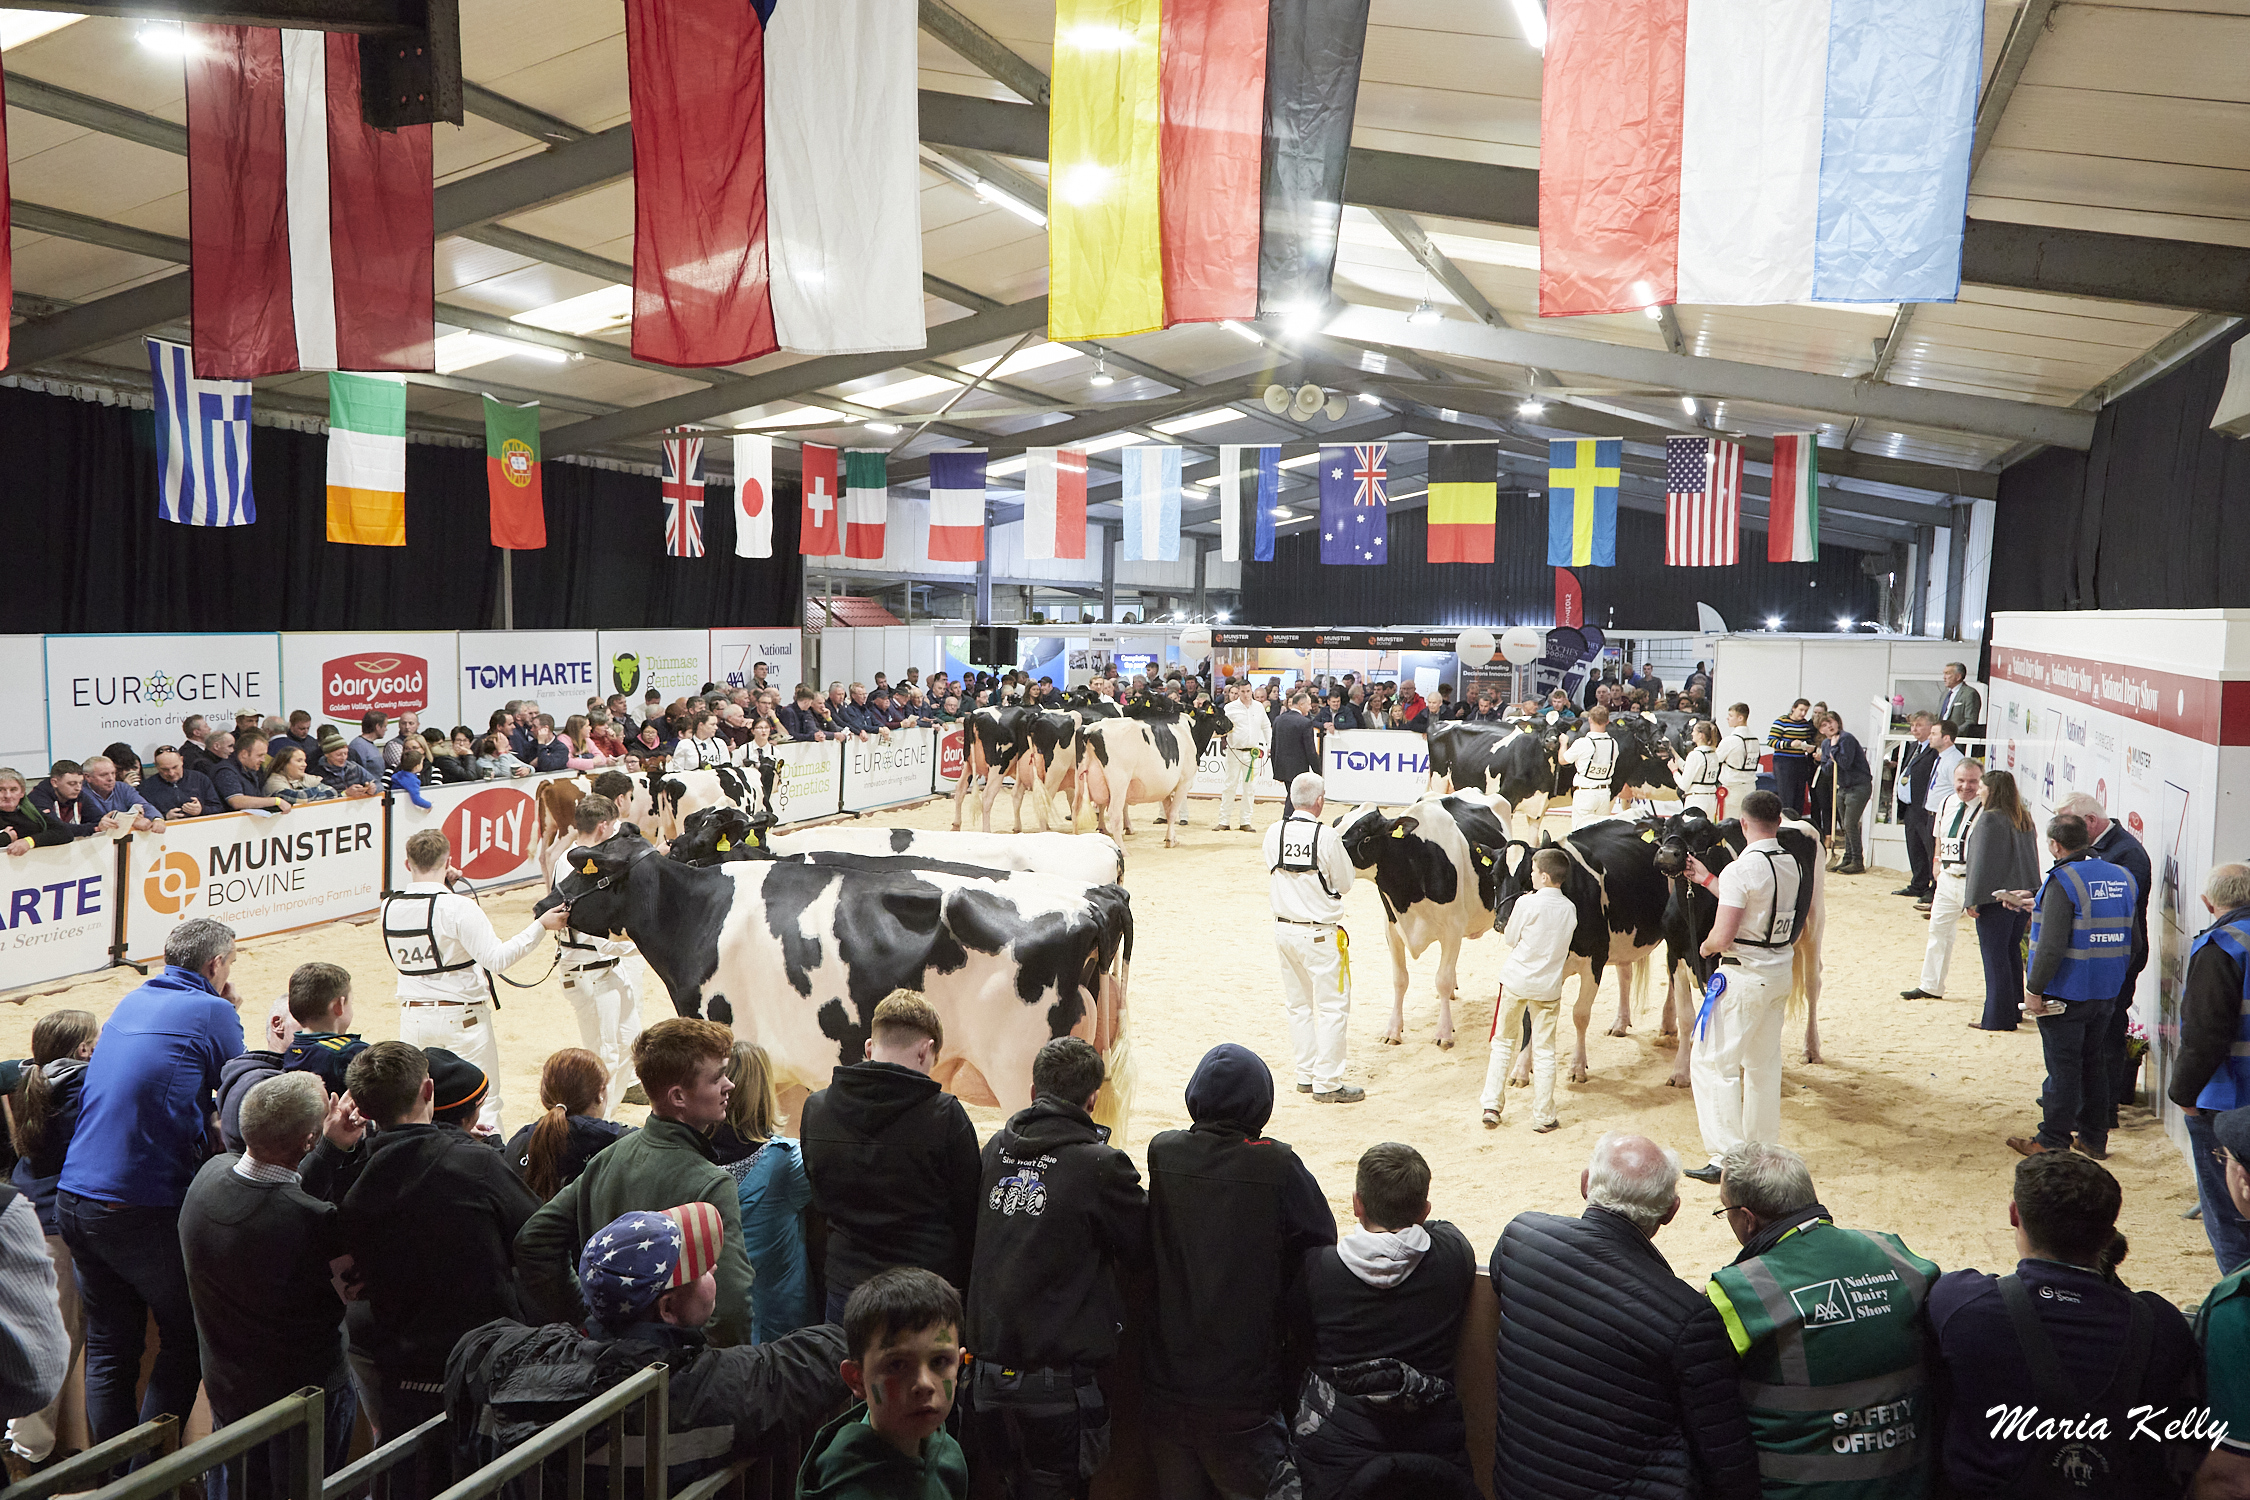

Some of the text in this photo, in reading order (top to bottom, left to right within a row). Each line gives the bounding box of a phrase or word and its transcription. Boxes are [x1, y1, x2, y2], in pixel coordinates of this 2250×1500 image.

[759, 643, 792, 657] National
[645, 656, 698, 671] Dúnmasc
[767, 662, 781, 677] airy
[465, 662, 592, 690] TOM HARTE
[646, 671, 698, 692] genetics
[536, 687, 586, 699] Farm Services
[2101, 673, 2124, 703] National
[2124, 677, 2141, 714] Dairy
[2140, 679, 2159, 712] Show
[329, 699, 422, 712] Golden Valleys, Growing Naturally
[101, 710, 238, 729] innovation drivi results
[782, 758, 831, 780] Dúnmasc
[1331, 750, 1390, 771] TOM
[1589, 766, 1608, 775] 239
[863, 773, 917, 789] innovation driving results
[460, 798, 526, 869] LELY
[209, 822, 373, 877] MUNSTER
[1284, 843, 1311, 858] 234
[208, 867, 306, 907] BOVINE
[0, 875, 102, 931] RTE
[207, 882, 372, 925] Collectively Improving Farm Life
[13, 924, 84, 949] Services
[2089, 933, 2125, 943] STEWAR
[397, 945, 434, 965] 244
[1002, 1155, 1015, 1164] She
[1037, 1160, 1048, 1170] Do
[1843, 1269, 1899, 1289] National
[1850, 1287, 1888, 1303] Dairy
[1814, 1300, 1845, 1322] AXA
[1856, 1303, 1891, 1319] Show
[1832, 1397, 1914, 1430] SAFETY
[1832, 1422, 1917, 1454] OFFICER
